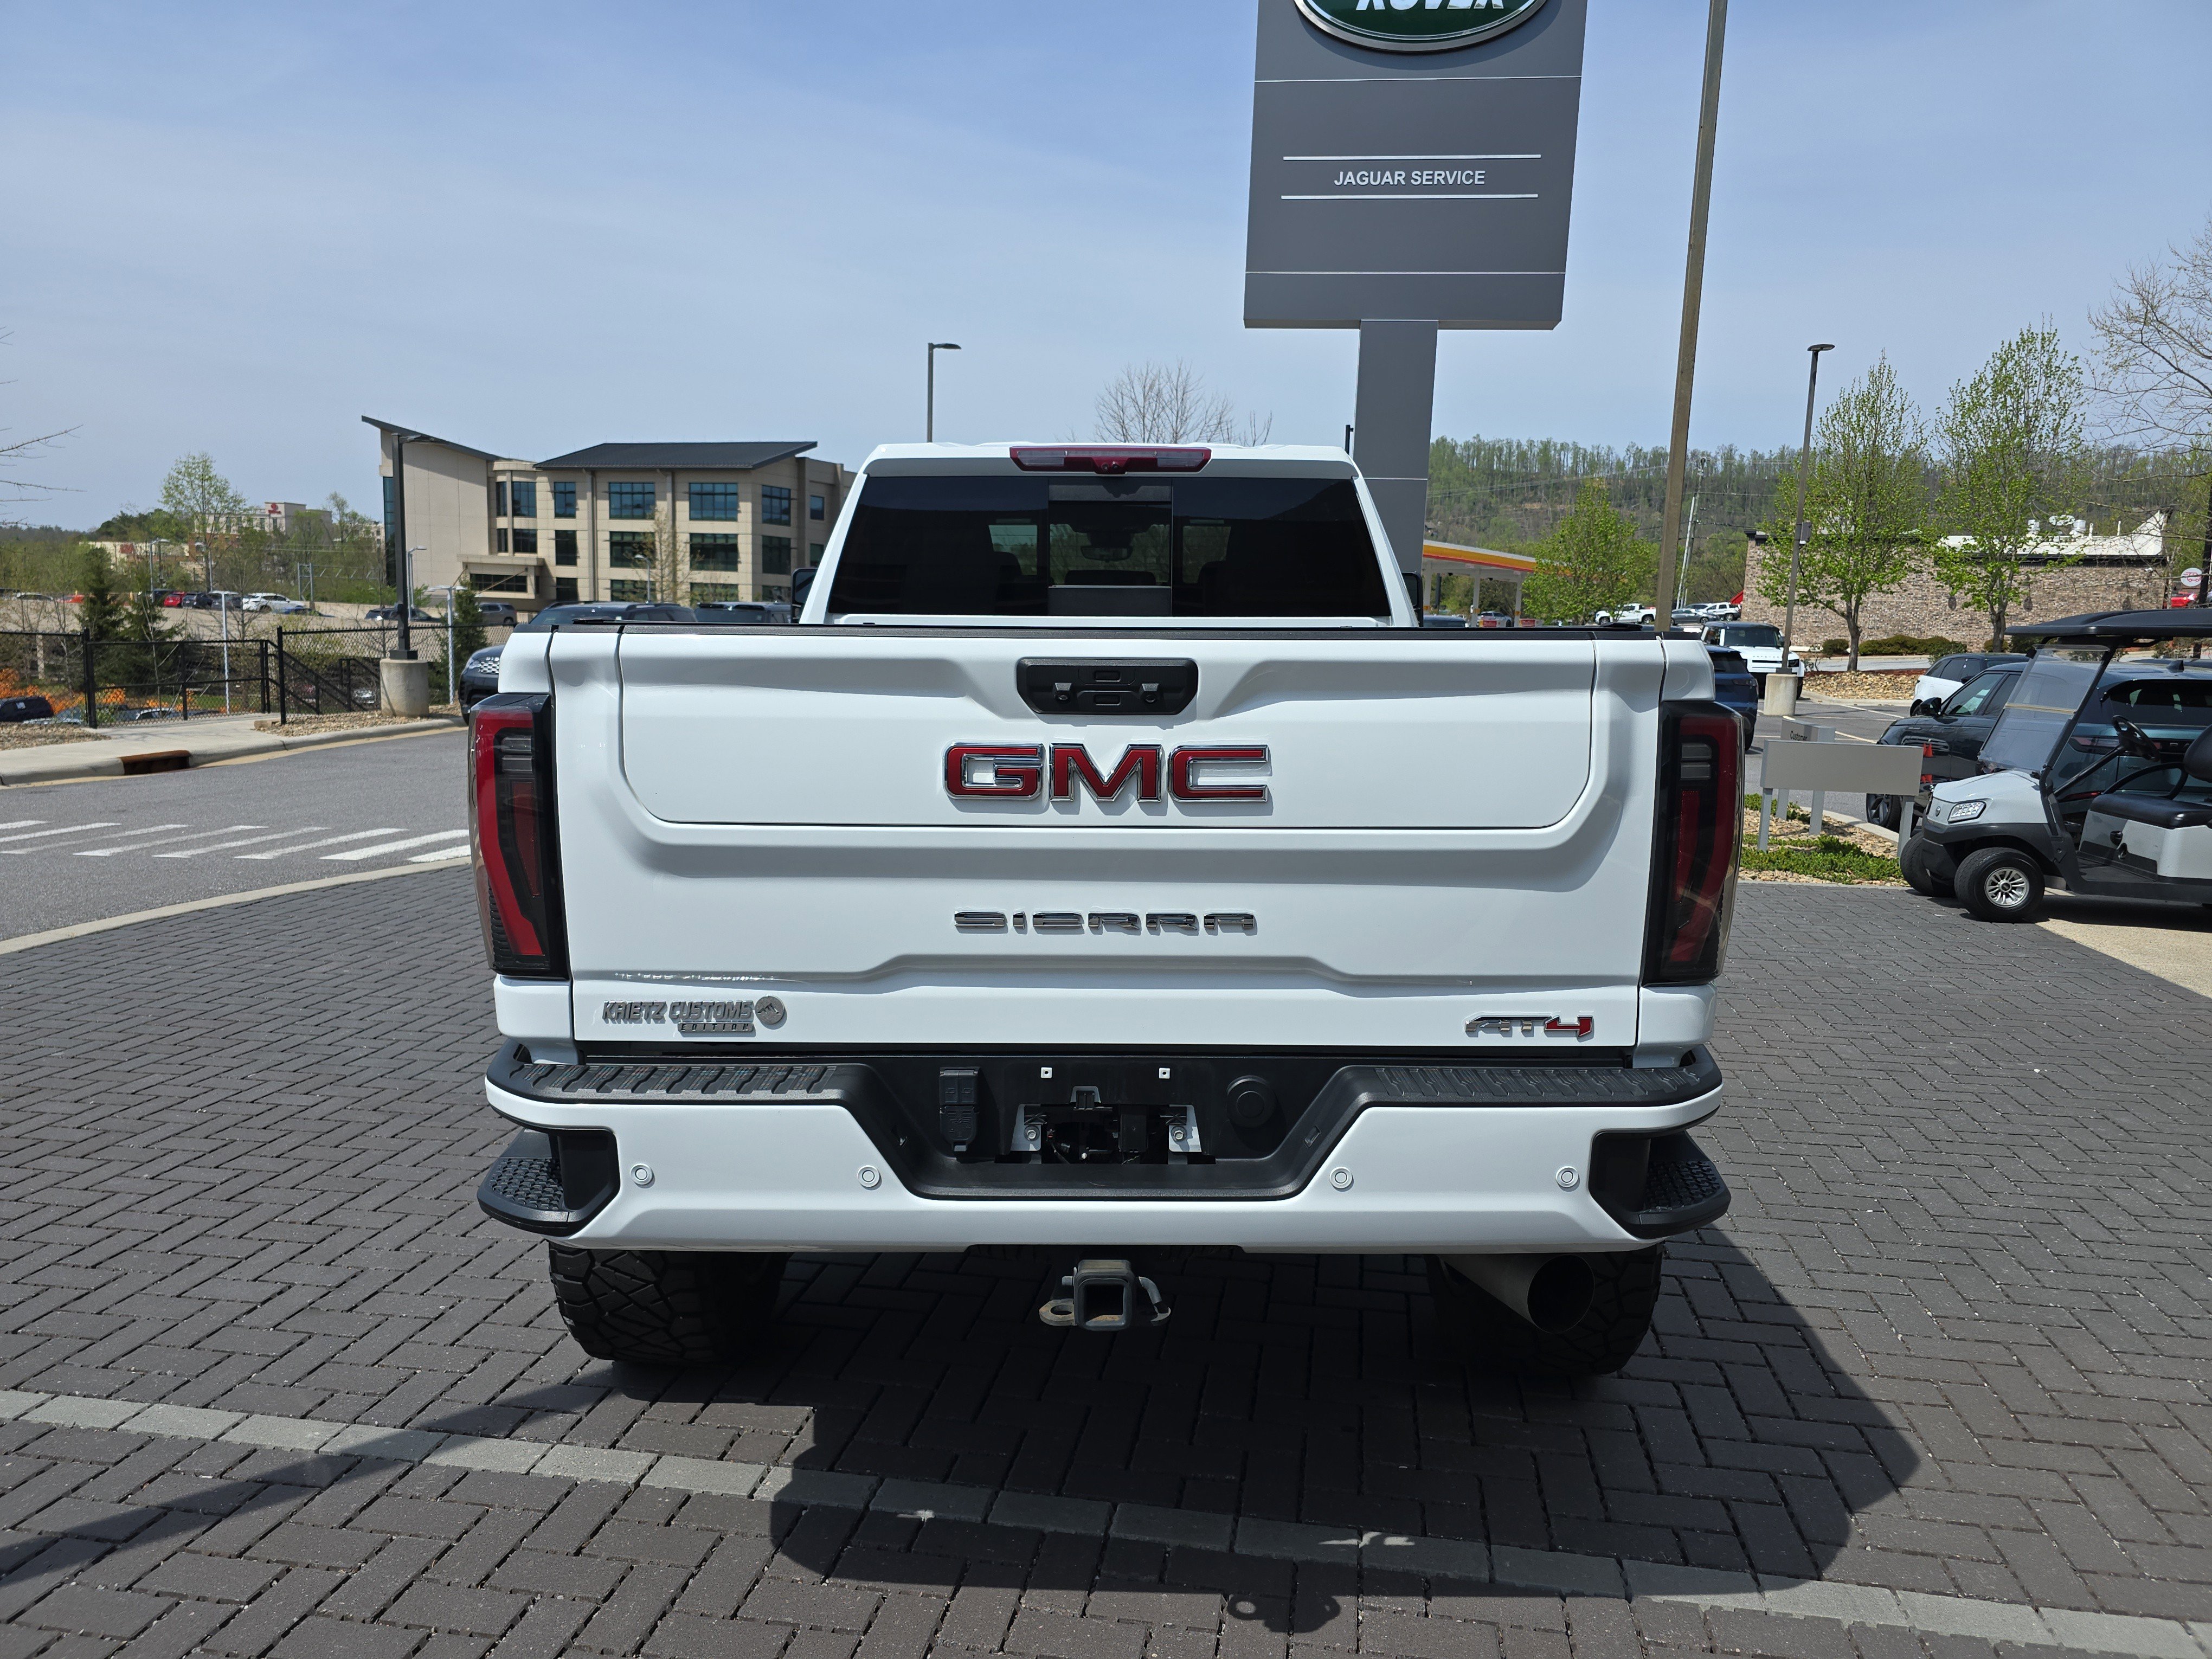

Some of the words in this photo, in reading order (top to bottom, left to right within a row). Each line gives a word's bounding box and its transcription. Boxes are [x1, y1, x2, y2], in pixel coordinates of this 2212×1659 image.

[1334, 171, 1406, 186] JAGUAR
[1410, 170, 1486, 185] SERVICE
[943, 742, 1269, 802] GMC
[954, 911, 1256, 931] SIERRA
[602, 1000, 667, 1020] KRIETZ
[668, 1000, 754, 1020] CUSTOMS
[680, 1023, 750, 1031] EDITION
[1464, 1015, 1594, 1037] AT4
